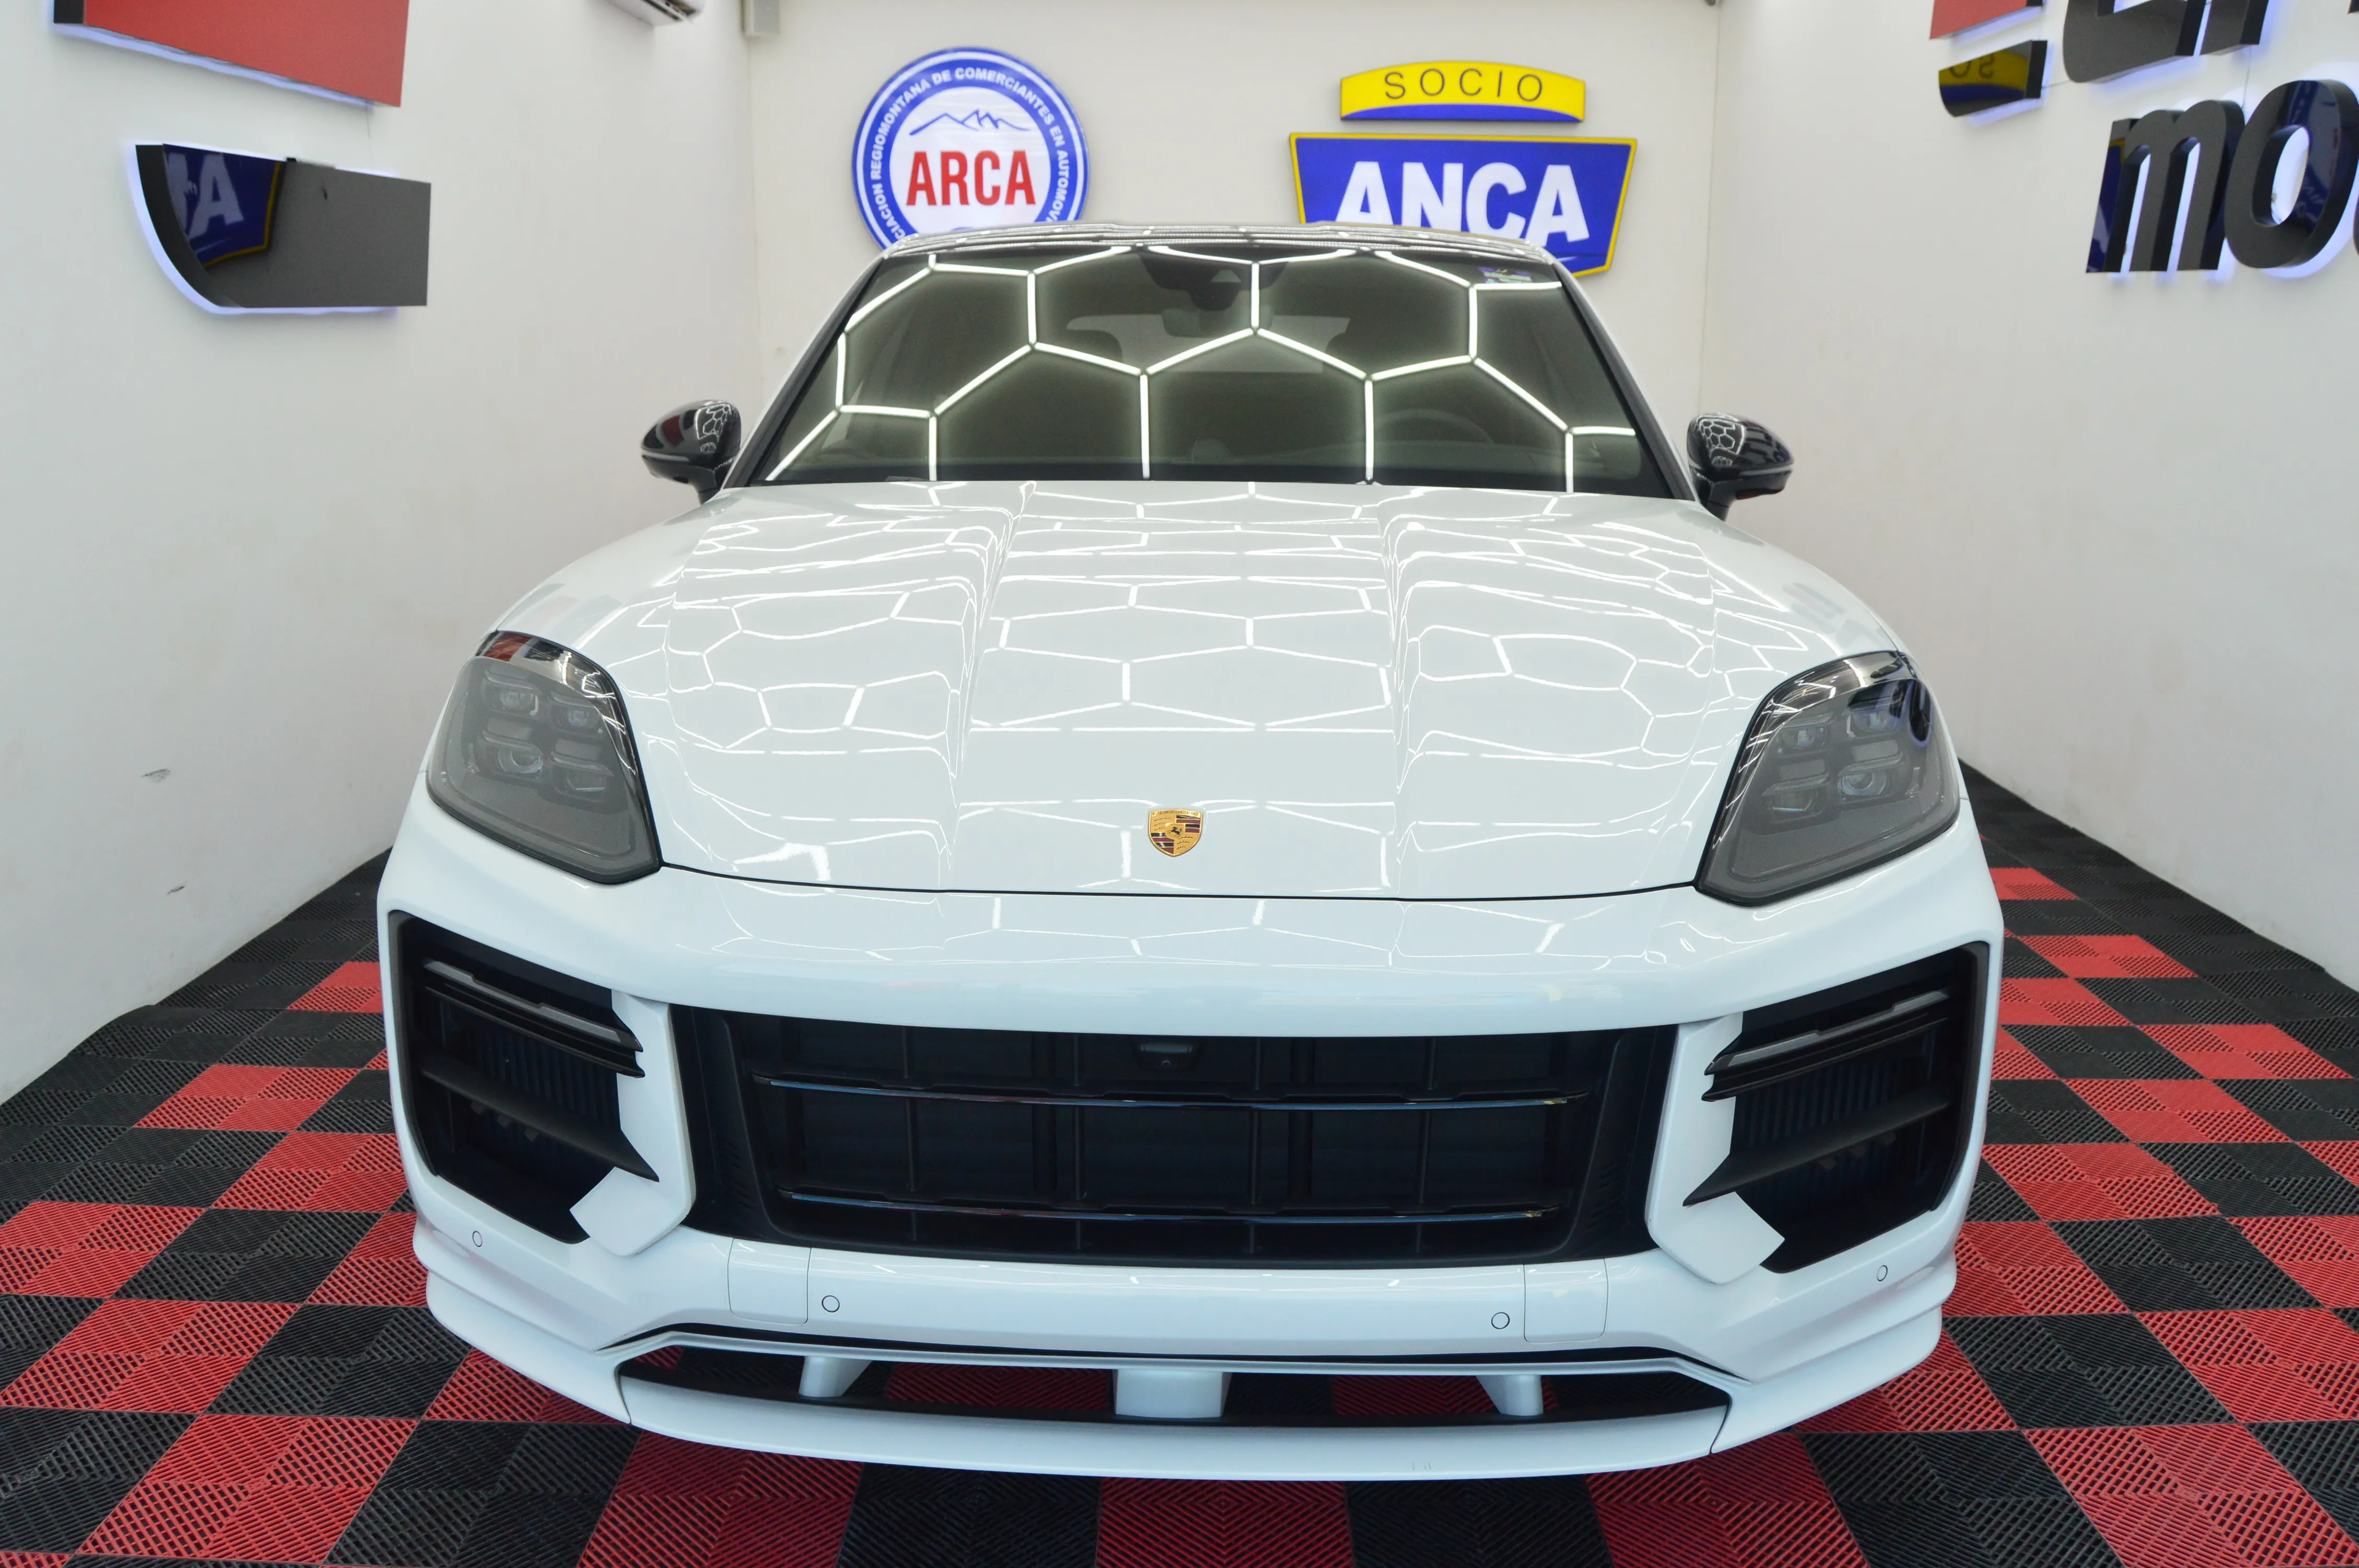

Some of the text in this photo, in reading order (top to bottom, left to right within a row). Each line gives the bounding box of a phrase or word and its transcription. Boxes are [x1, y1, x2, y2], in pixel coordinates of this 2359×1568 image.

[932, 70, 952, 85] DE
[955, 67, 1055, 125] COMERCIANTES
[1384, 68, 1543, 101] SOCIO
[871, 78, 931, 180] REGIOMONTANA
[1049, 125, 1066, 147] EN
[906, 150, 1036, 206] ARCA
[1336, 161, 1590, 247] ANCA
[2086, 79, 2359, 274] mo
[872, 183, 906, 240] CIACION
